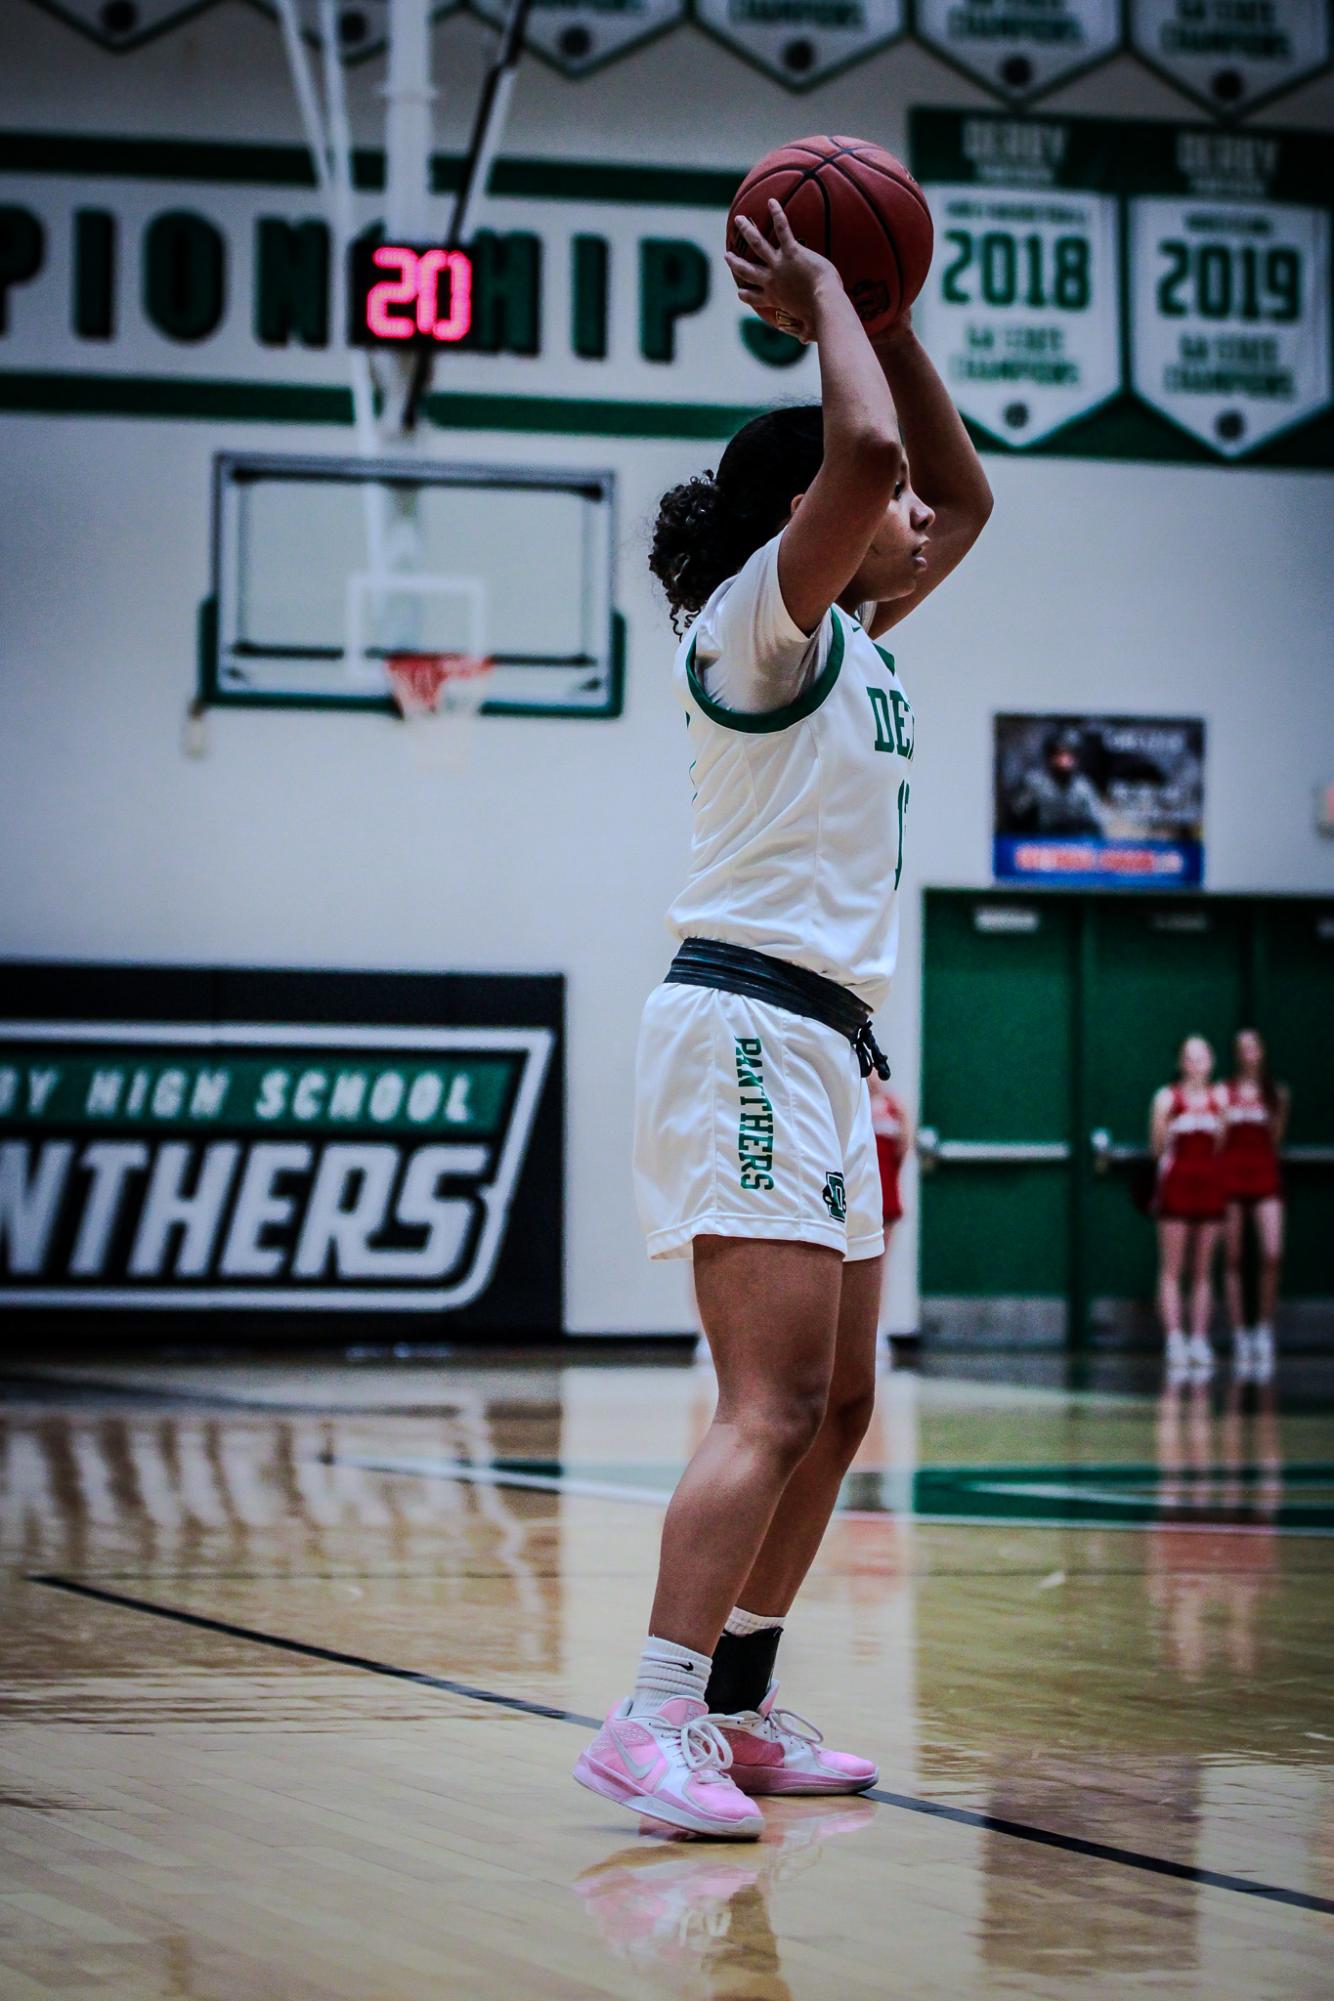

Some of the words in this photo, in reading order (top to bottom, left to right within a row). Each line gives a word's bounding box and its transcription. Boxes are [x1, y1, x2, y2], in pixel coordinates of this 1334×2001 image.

[367, 246, 471, 341] 20
[942, 230, 1090, 311] 2018
[1157, 239, 1301, 323] 2019
[866, 686, 915, 760] DE
[86, 1067, 231, 1120] HIGH
[255, 1069, 474, 1123] SCHOOL
[735, 1036, 774, 1191] PANTHERS
